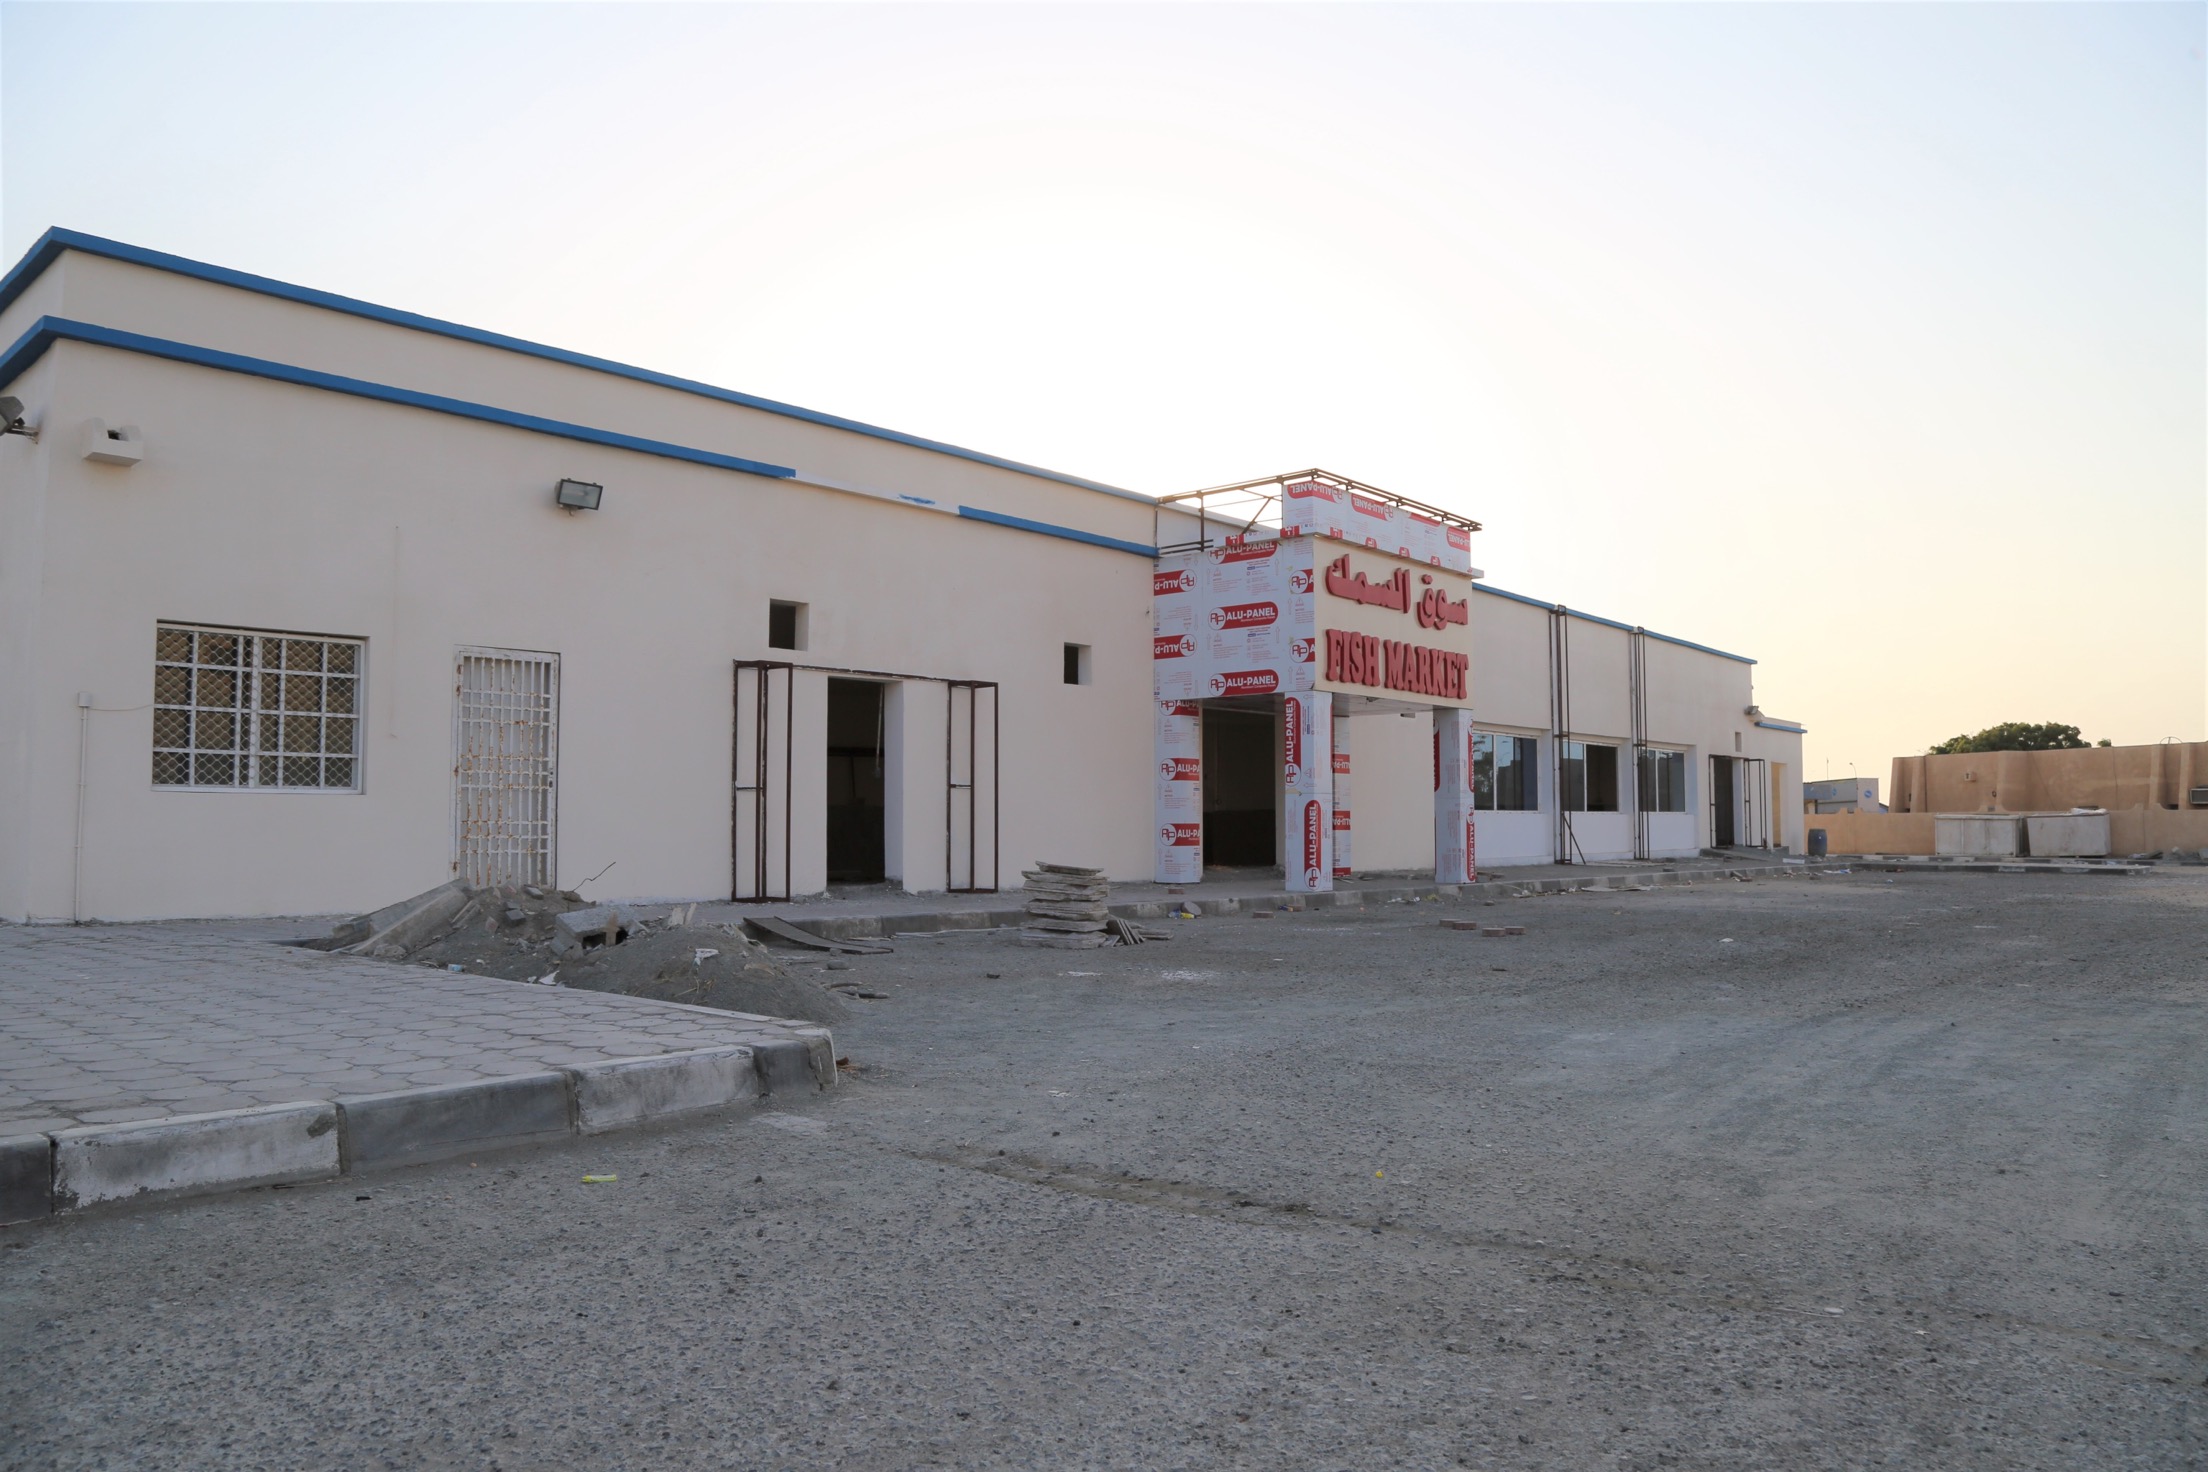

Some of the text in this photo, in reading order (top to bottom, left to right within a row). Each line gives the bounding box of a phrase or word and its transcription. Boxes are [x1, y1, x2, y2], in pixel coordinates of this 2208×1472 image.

[1290, 482, 1333, 496] ALU-PANEL
[1353, 497, 1384, 514] ALU-PANEL
[1225, 541, 1275, 555] ALU-PANEL
[1325, 554, 1411, 613] السمك
[1226, 607, 1276, 620] ALU-PANEL
[1417, 574, 1468, 630] سوق
[1226, 675, 1276, 687] ALU-PANEL
[1325, 628, 1380, 687] FISH
[1383, 639, 1469, 699] MARKET
[1285, 700, 1294, 762] ALU-PANEL
[1309, 804, 1317, 866] ALU-PANEL
